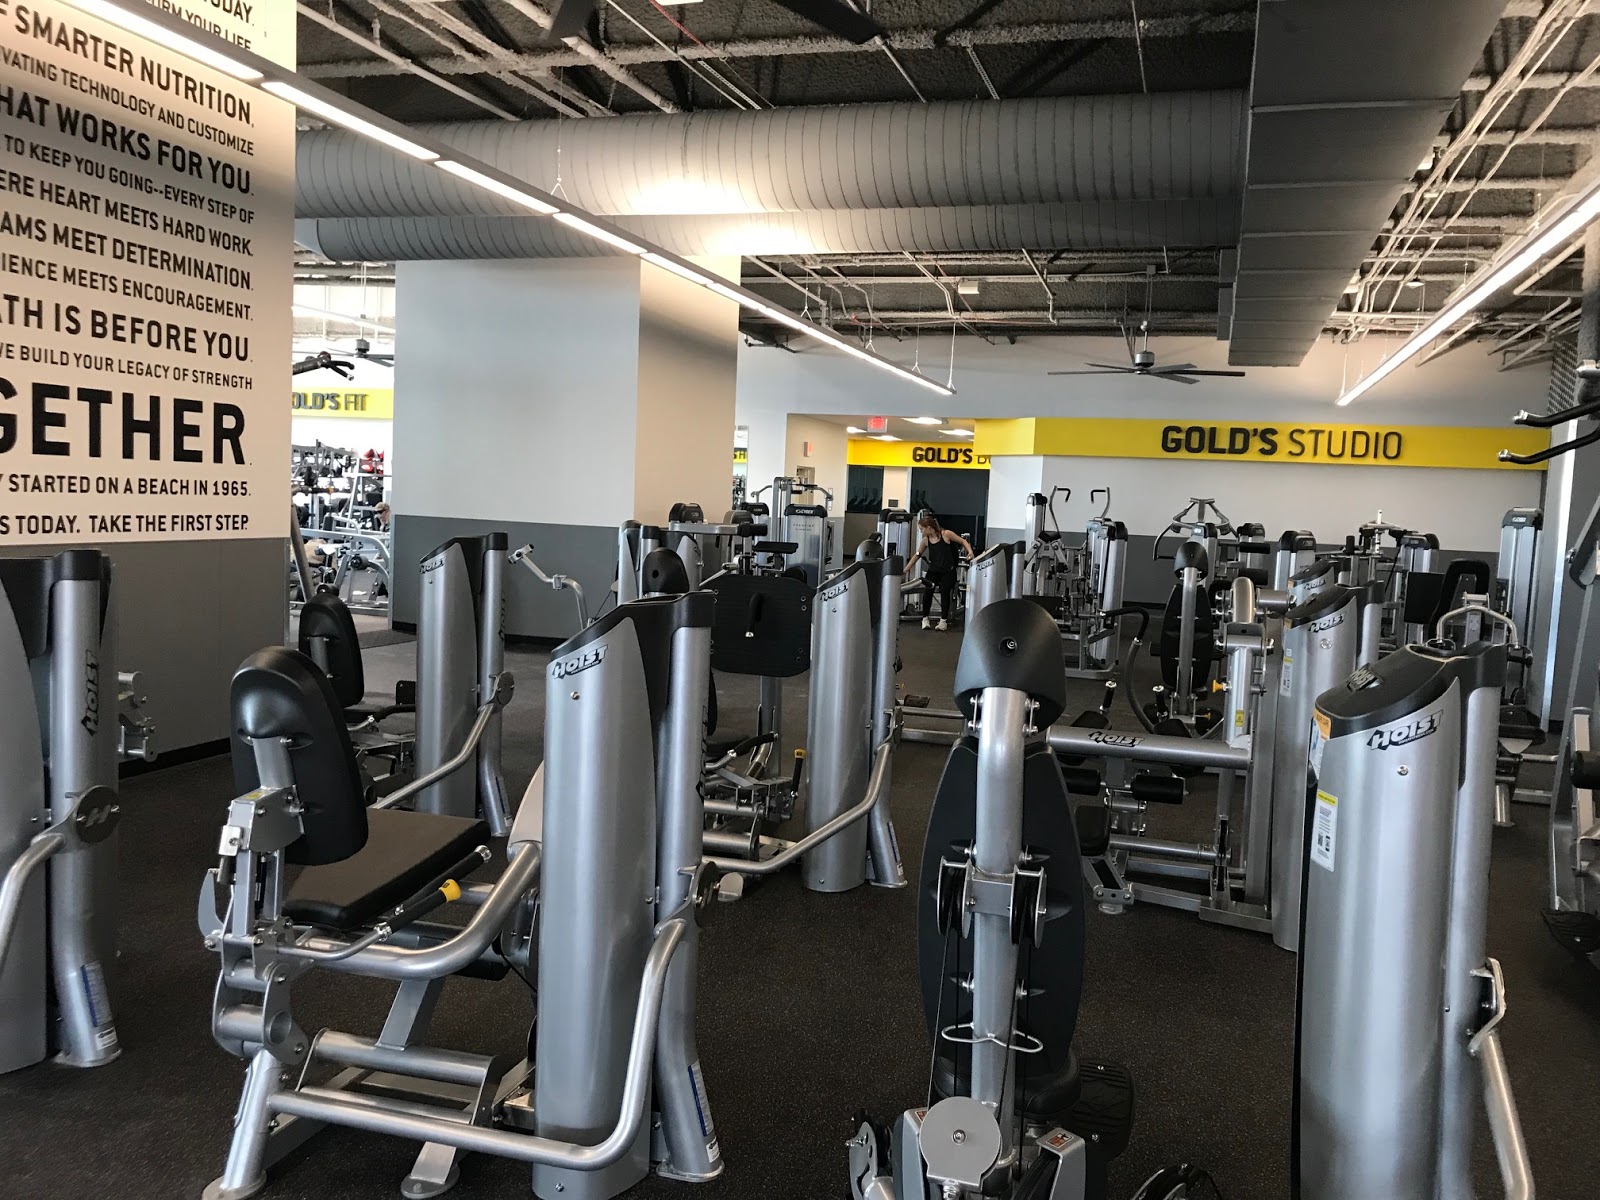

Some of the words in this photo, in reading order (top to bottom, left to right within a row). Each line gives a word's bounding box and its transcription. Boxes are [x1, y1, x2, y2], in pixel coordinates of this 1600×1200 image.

[15, 5, 133, 77] SMARTER
[61, 68, 155, 118] TECHNOLOGY
[158, 107, 184, 129] AND
[188, 118, 253, 156] CUSTOMIZE
[56, 103, 151, 160] WORKS
[158, 139, 203, 179] FOR
[207, 157, 254, 196] YOU.
[4, 134, 25, 155] TO
[30, 142, 71, 168] KEEP
[74, 155, 105, 179] YOU
[208, 198, 237, 219] STEP
[239, 208, 254, 224] OF
[40, 180, 101, 214] HEART
[105, 199, 158, 230] MEETS
[163, 215, 205, 243] HARD
[0, 211, 47, 242] AMS
[53, 223, 107, 256] MEET
[113, 238, 253, 290] DETERMINATION.
[63, 266, 118, 293] MEETS
[123, 279, 253, 320] ENCOURAGEMENT.
[0, 294, 43, 329] TH
[55, 303, 81, 335] IS
[91, 310, 196, 353] BEFORE
[203, 330, 253, 362] YOU.
[20, 345, 69, 366] BUILD
[73, 353, 114, 372] YOUR
[118, 359, 170, 379] LEGACY
[173, 367, 189, 381] OF
[192, 370, 252, 390] STRENGTH
[344, 393, 369, 411] FIT
[912, 446, 974, 465] GOLD'S
[1161, 425, 1279, 456] GOLD'S
[1288, 428, 1403, 460] STUDIO
[9, 474, 90, 493] STARTED
[96, 477, 118, 494] ON
[123, 478, 133, 494] A
[138, 478, 189, 495] BEACH
[194, 480, 207, 495] IN
[213, 481, 251, 496] 1965.
[15, 515, 80, 534] TODAY.
[89, 515, 131, 533] TAKE
[136, 515, 166, 532] THE
[171, 515, 212, 531] FIRST
[215, 514, 248, 531] STEP.
[552, 644, 608, 680] HOIST
[1088, 731, 1145, 748] HOIST
[1367, 709, 1444, 751] HOIST
